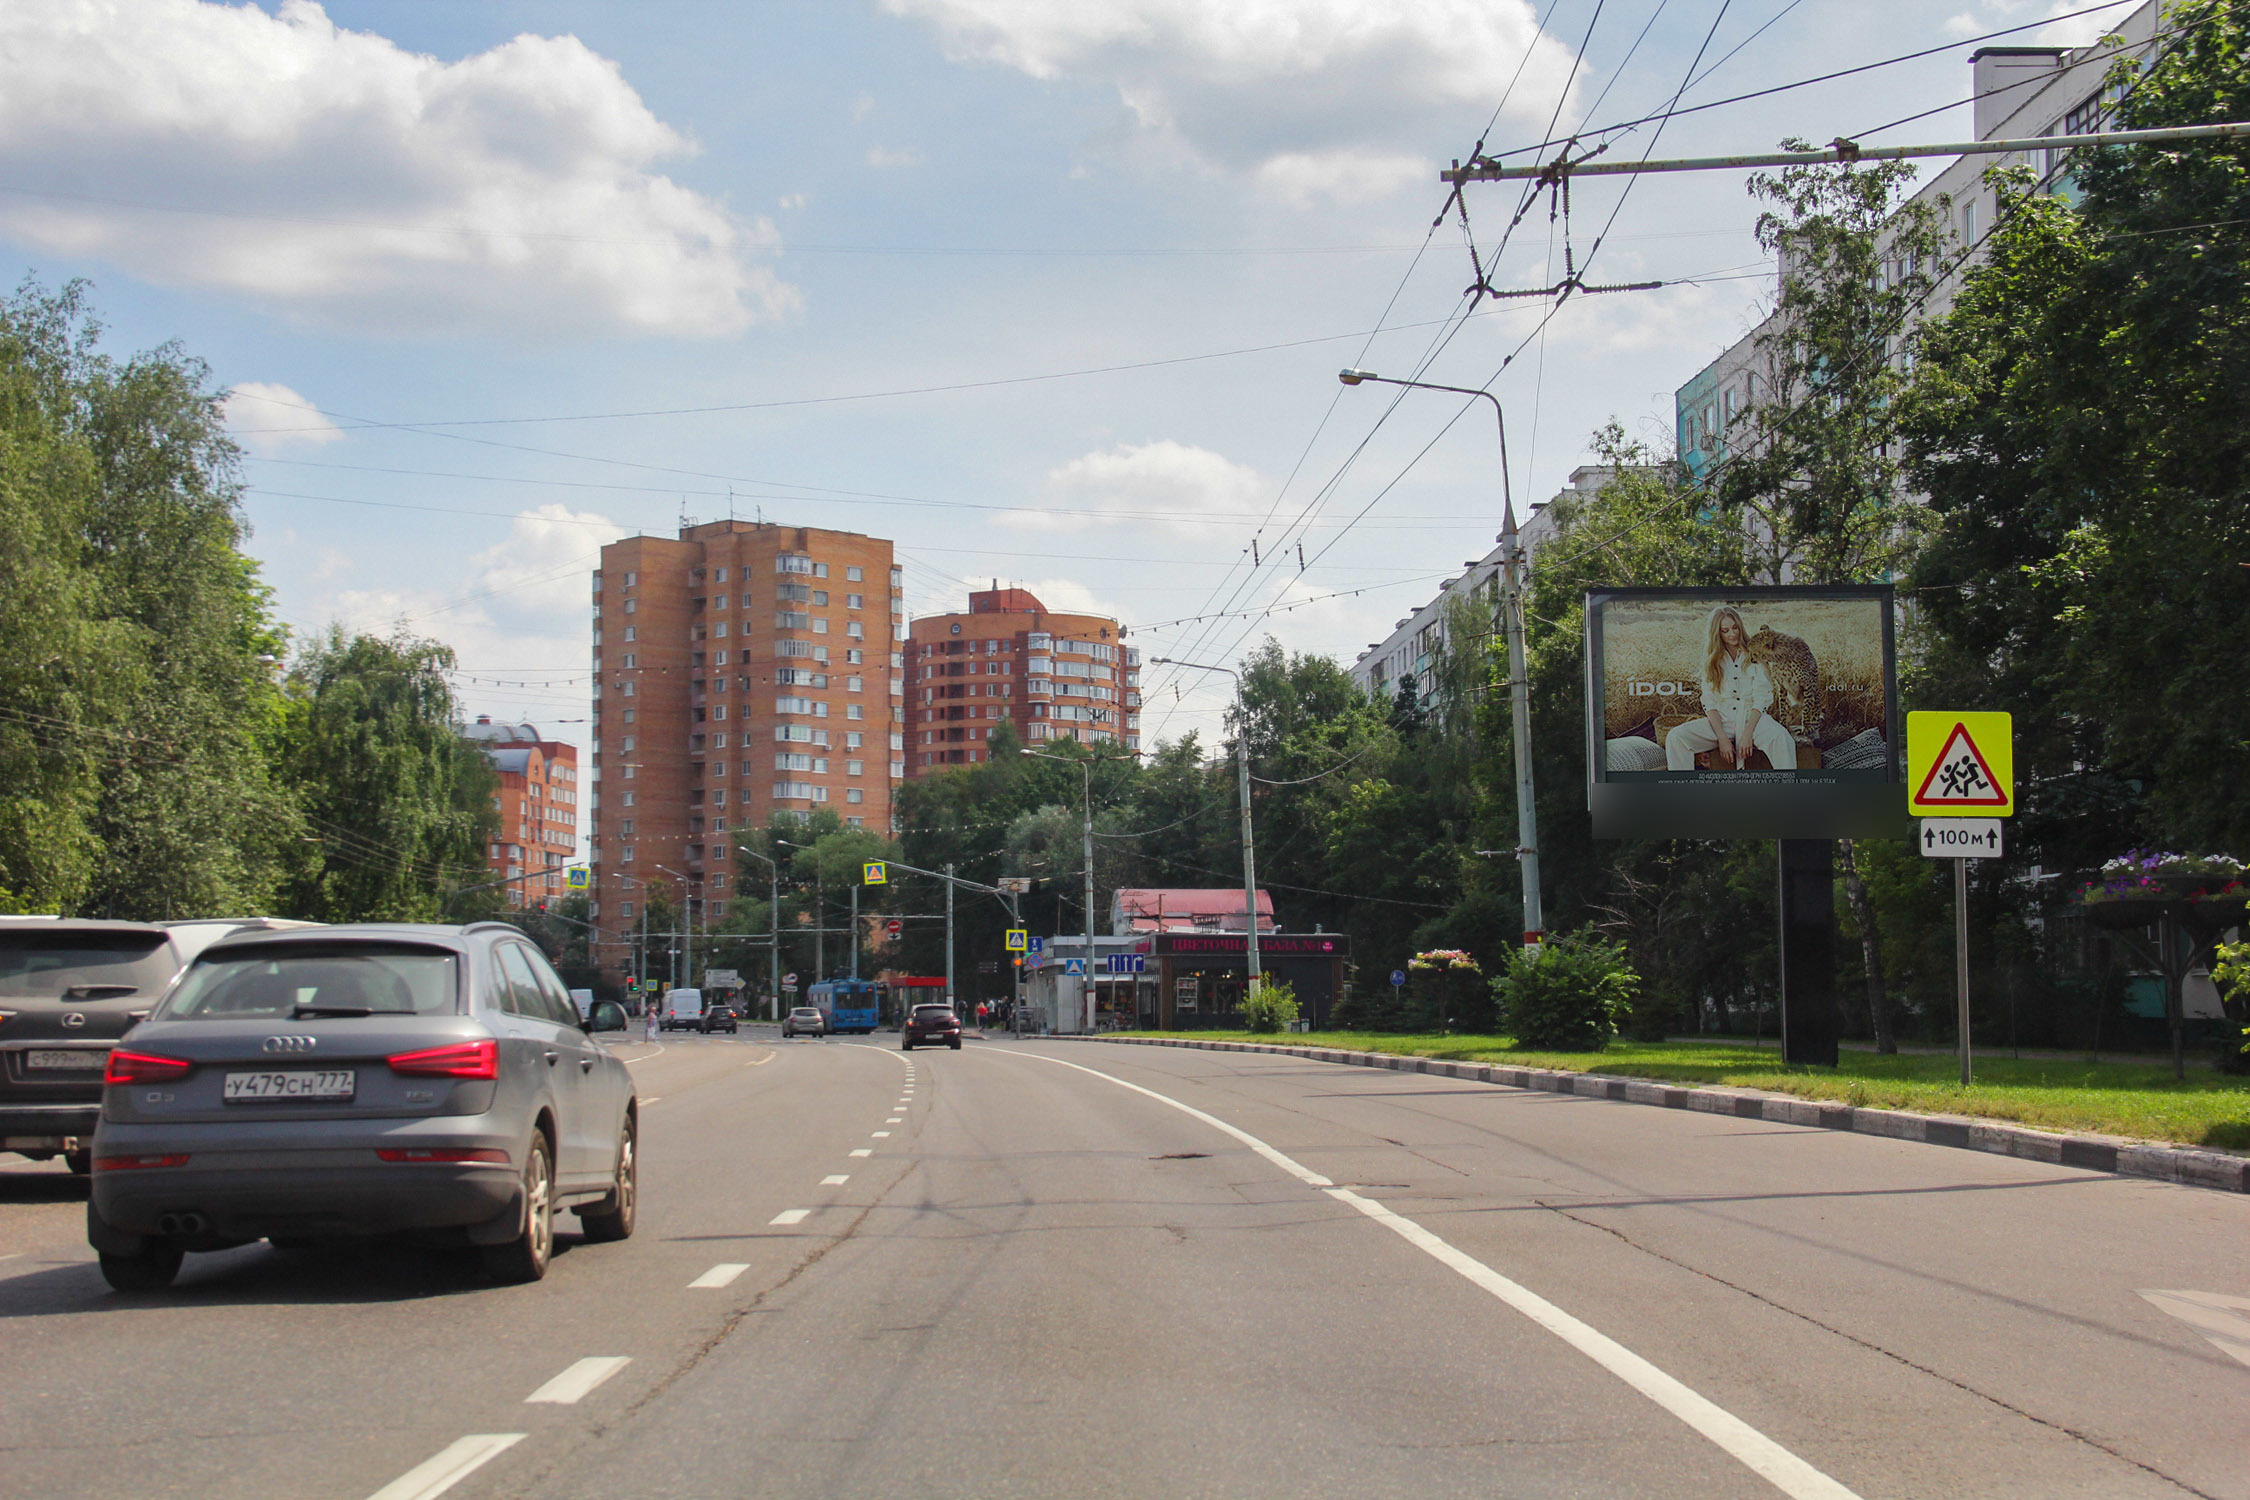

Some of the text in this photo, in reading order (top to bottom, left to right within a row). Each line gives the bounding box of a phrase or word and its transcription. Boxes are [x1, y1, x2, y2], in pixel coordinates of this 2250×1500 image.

[1825, 682, 1864, 691] idol.ru
[1939, 830, 1983, 845] 100м
[1172, 938, 1259, 952] ЦВЕТОЧНА
[1263, 939, 1298, 951] БАЗА
[317, 1073, 349, 1088] 777
